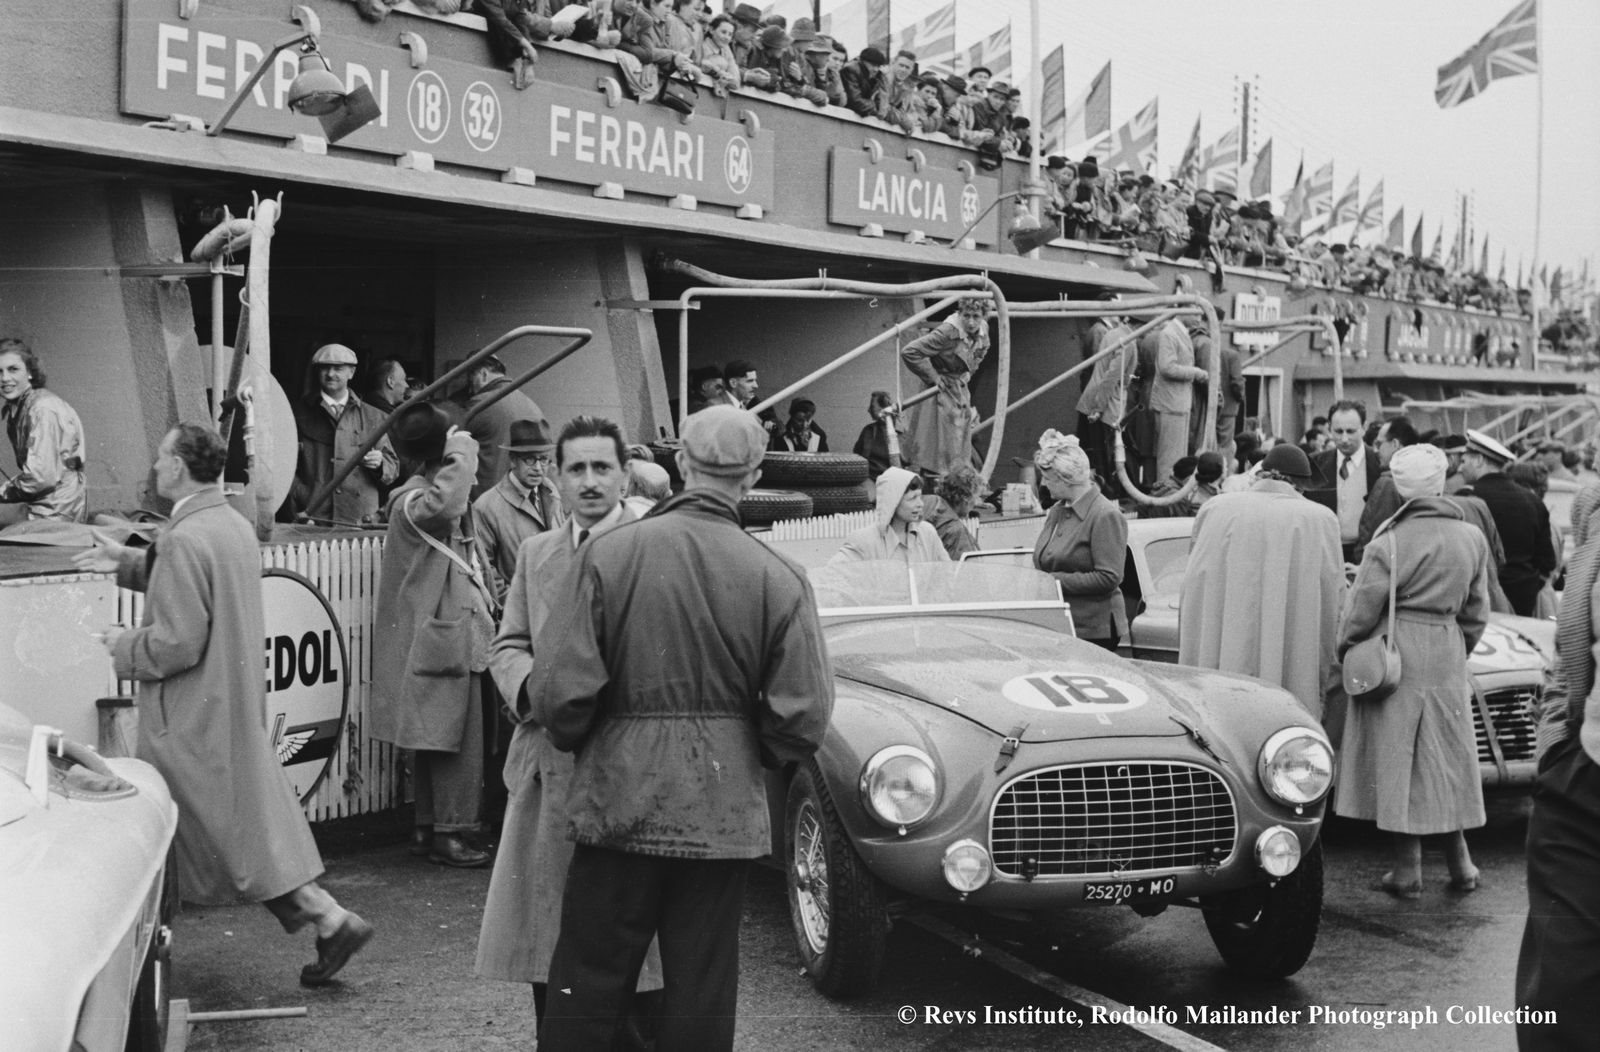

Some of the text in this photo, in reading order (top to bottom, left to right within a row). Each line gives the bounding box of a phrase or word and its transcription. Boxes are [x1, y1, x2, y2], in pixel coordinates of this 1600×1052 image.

[416, 81, 441, 132] 18
[468, 91, 495, 140] 32
[550, 104, 749, 185] FERRARI 64
[858, 168, 948, 222] LANCIA
[1024, 674, 1130, 708] 18
[1086, 879, 1174, 900] 25270 MO
